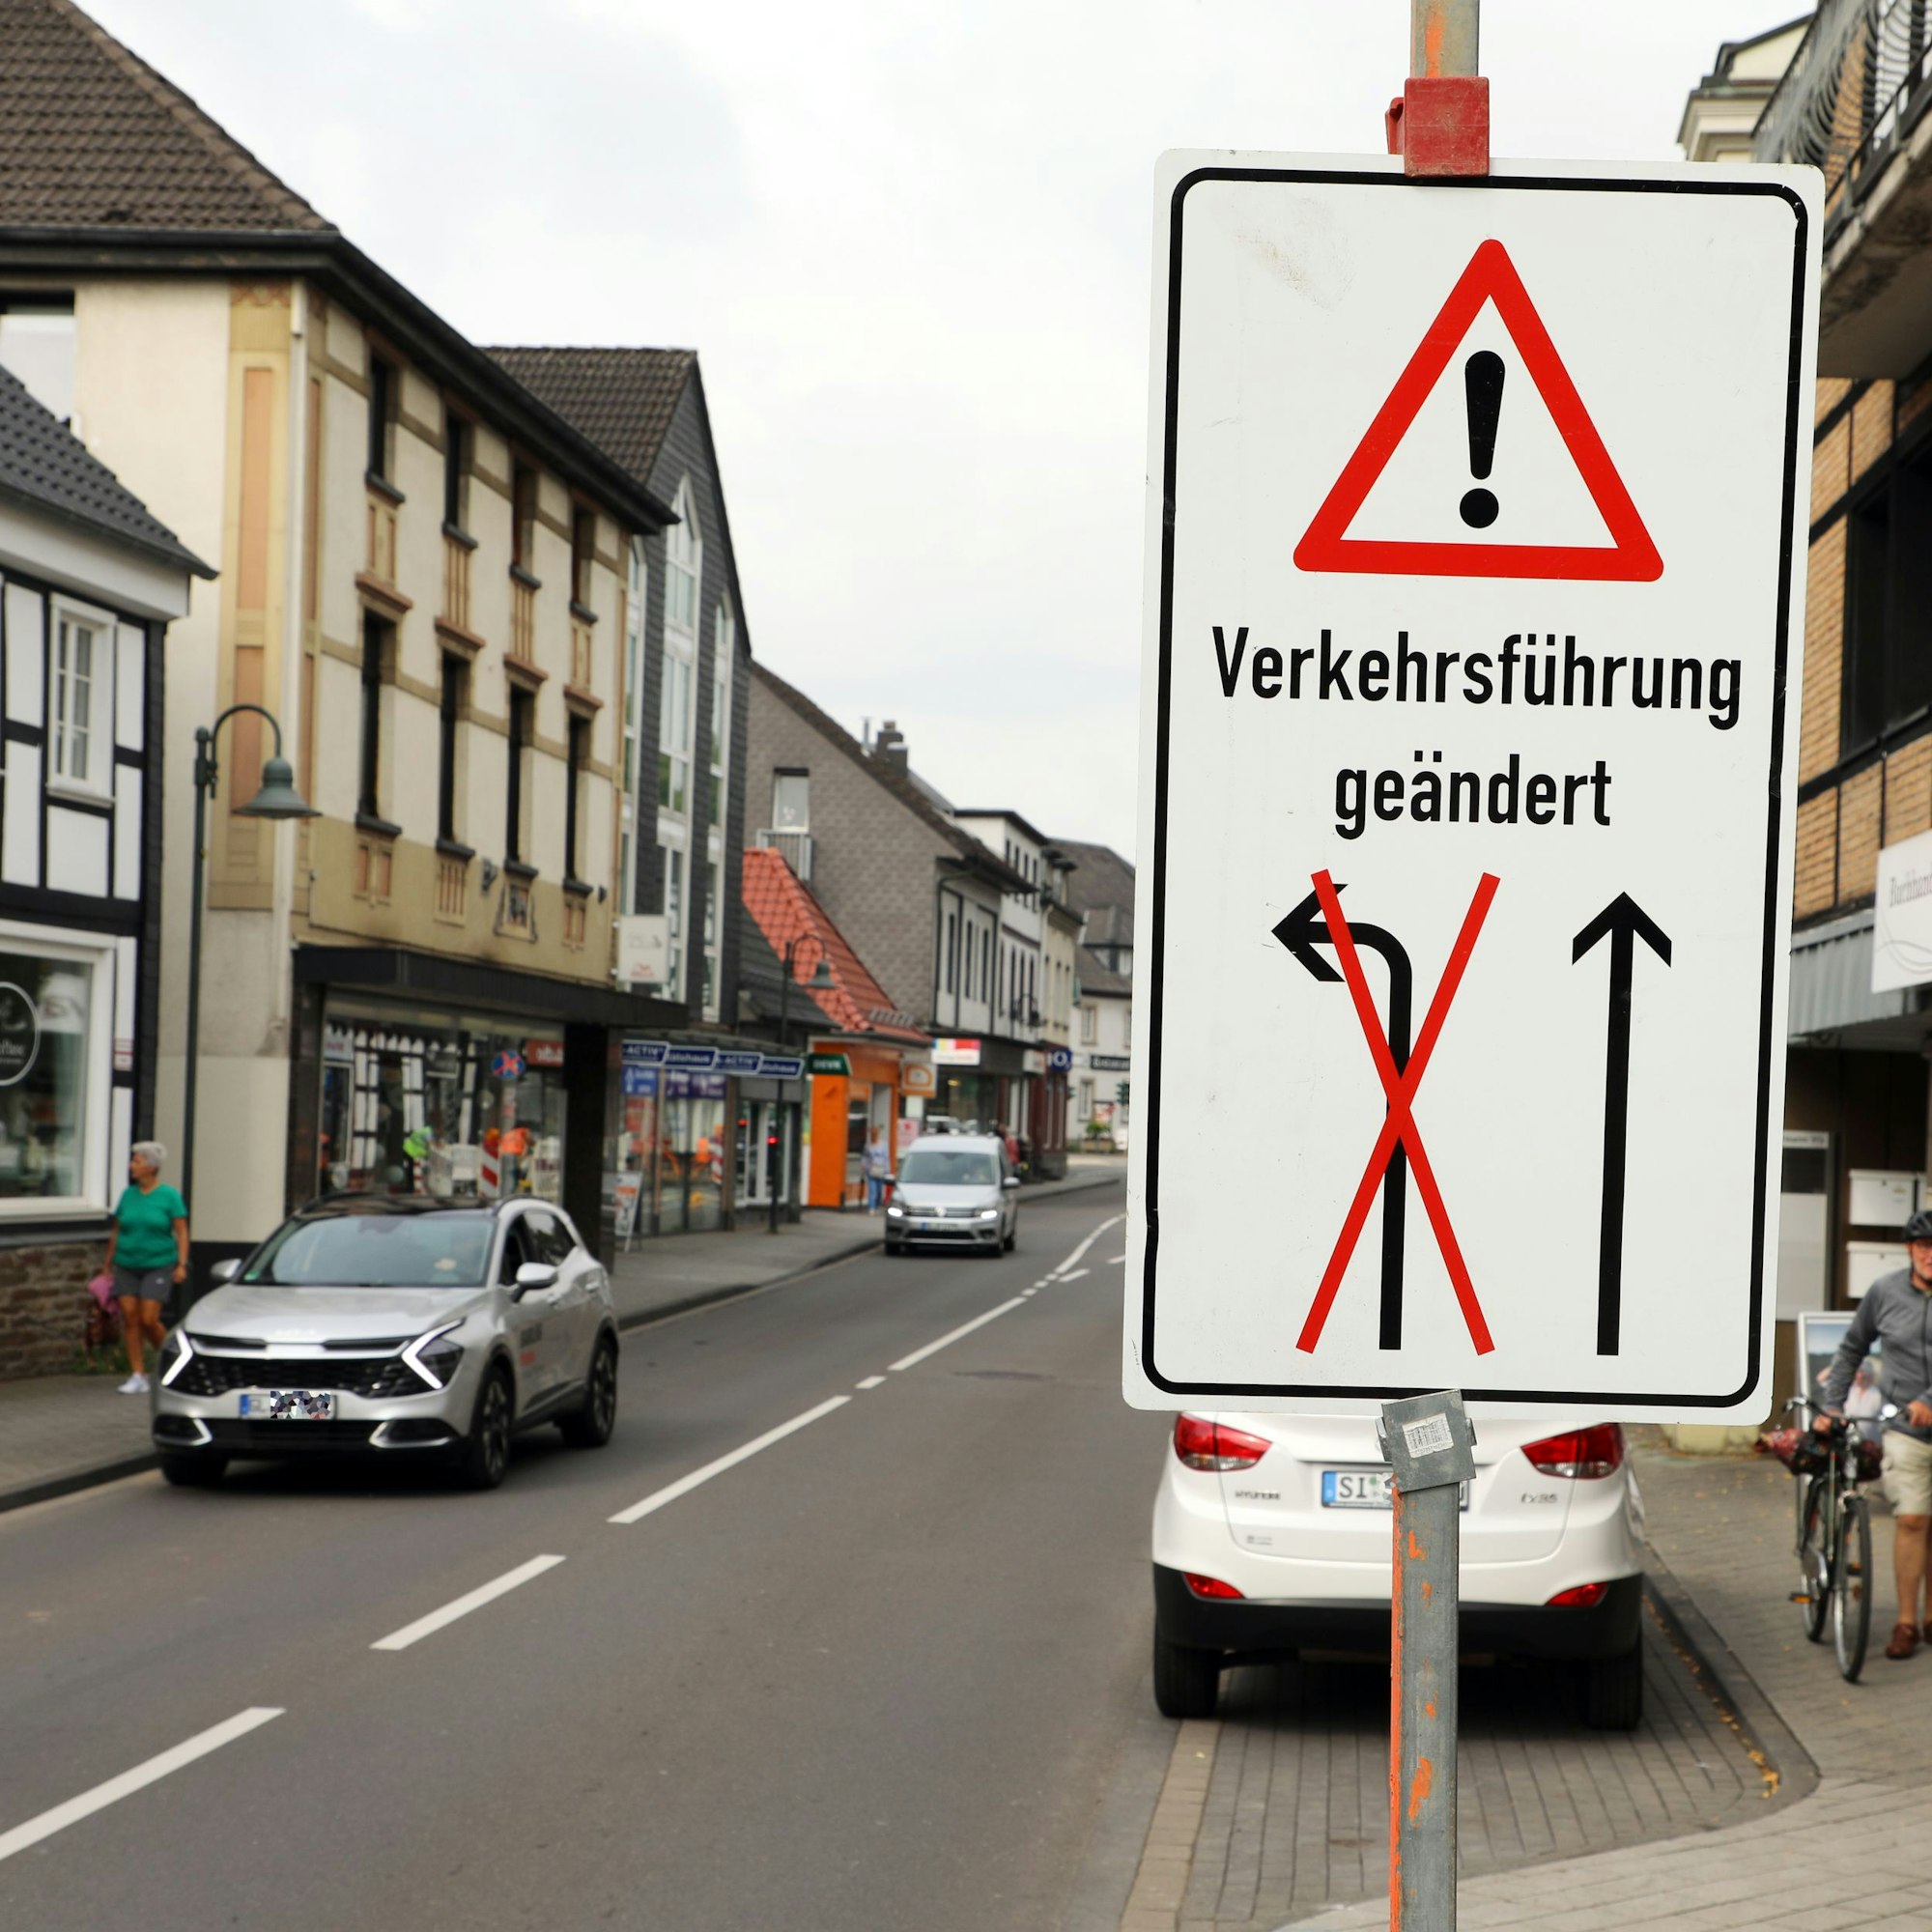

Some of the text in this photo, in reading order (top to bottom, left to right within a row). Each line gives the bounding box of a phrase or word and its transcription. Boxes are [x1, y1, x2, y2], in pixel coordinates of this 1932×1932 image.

[1211, 625, 1742, 730] Verkehrsführung
[1335, 750, 1612, 840] geändert
[1339, 1477, 1367, 1498] SI
